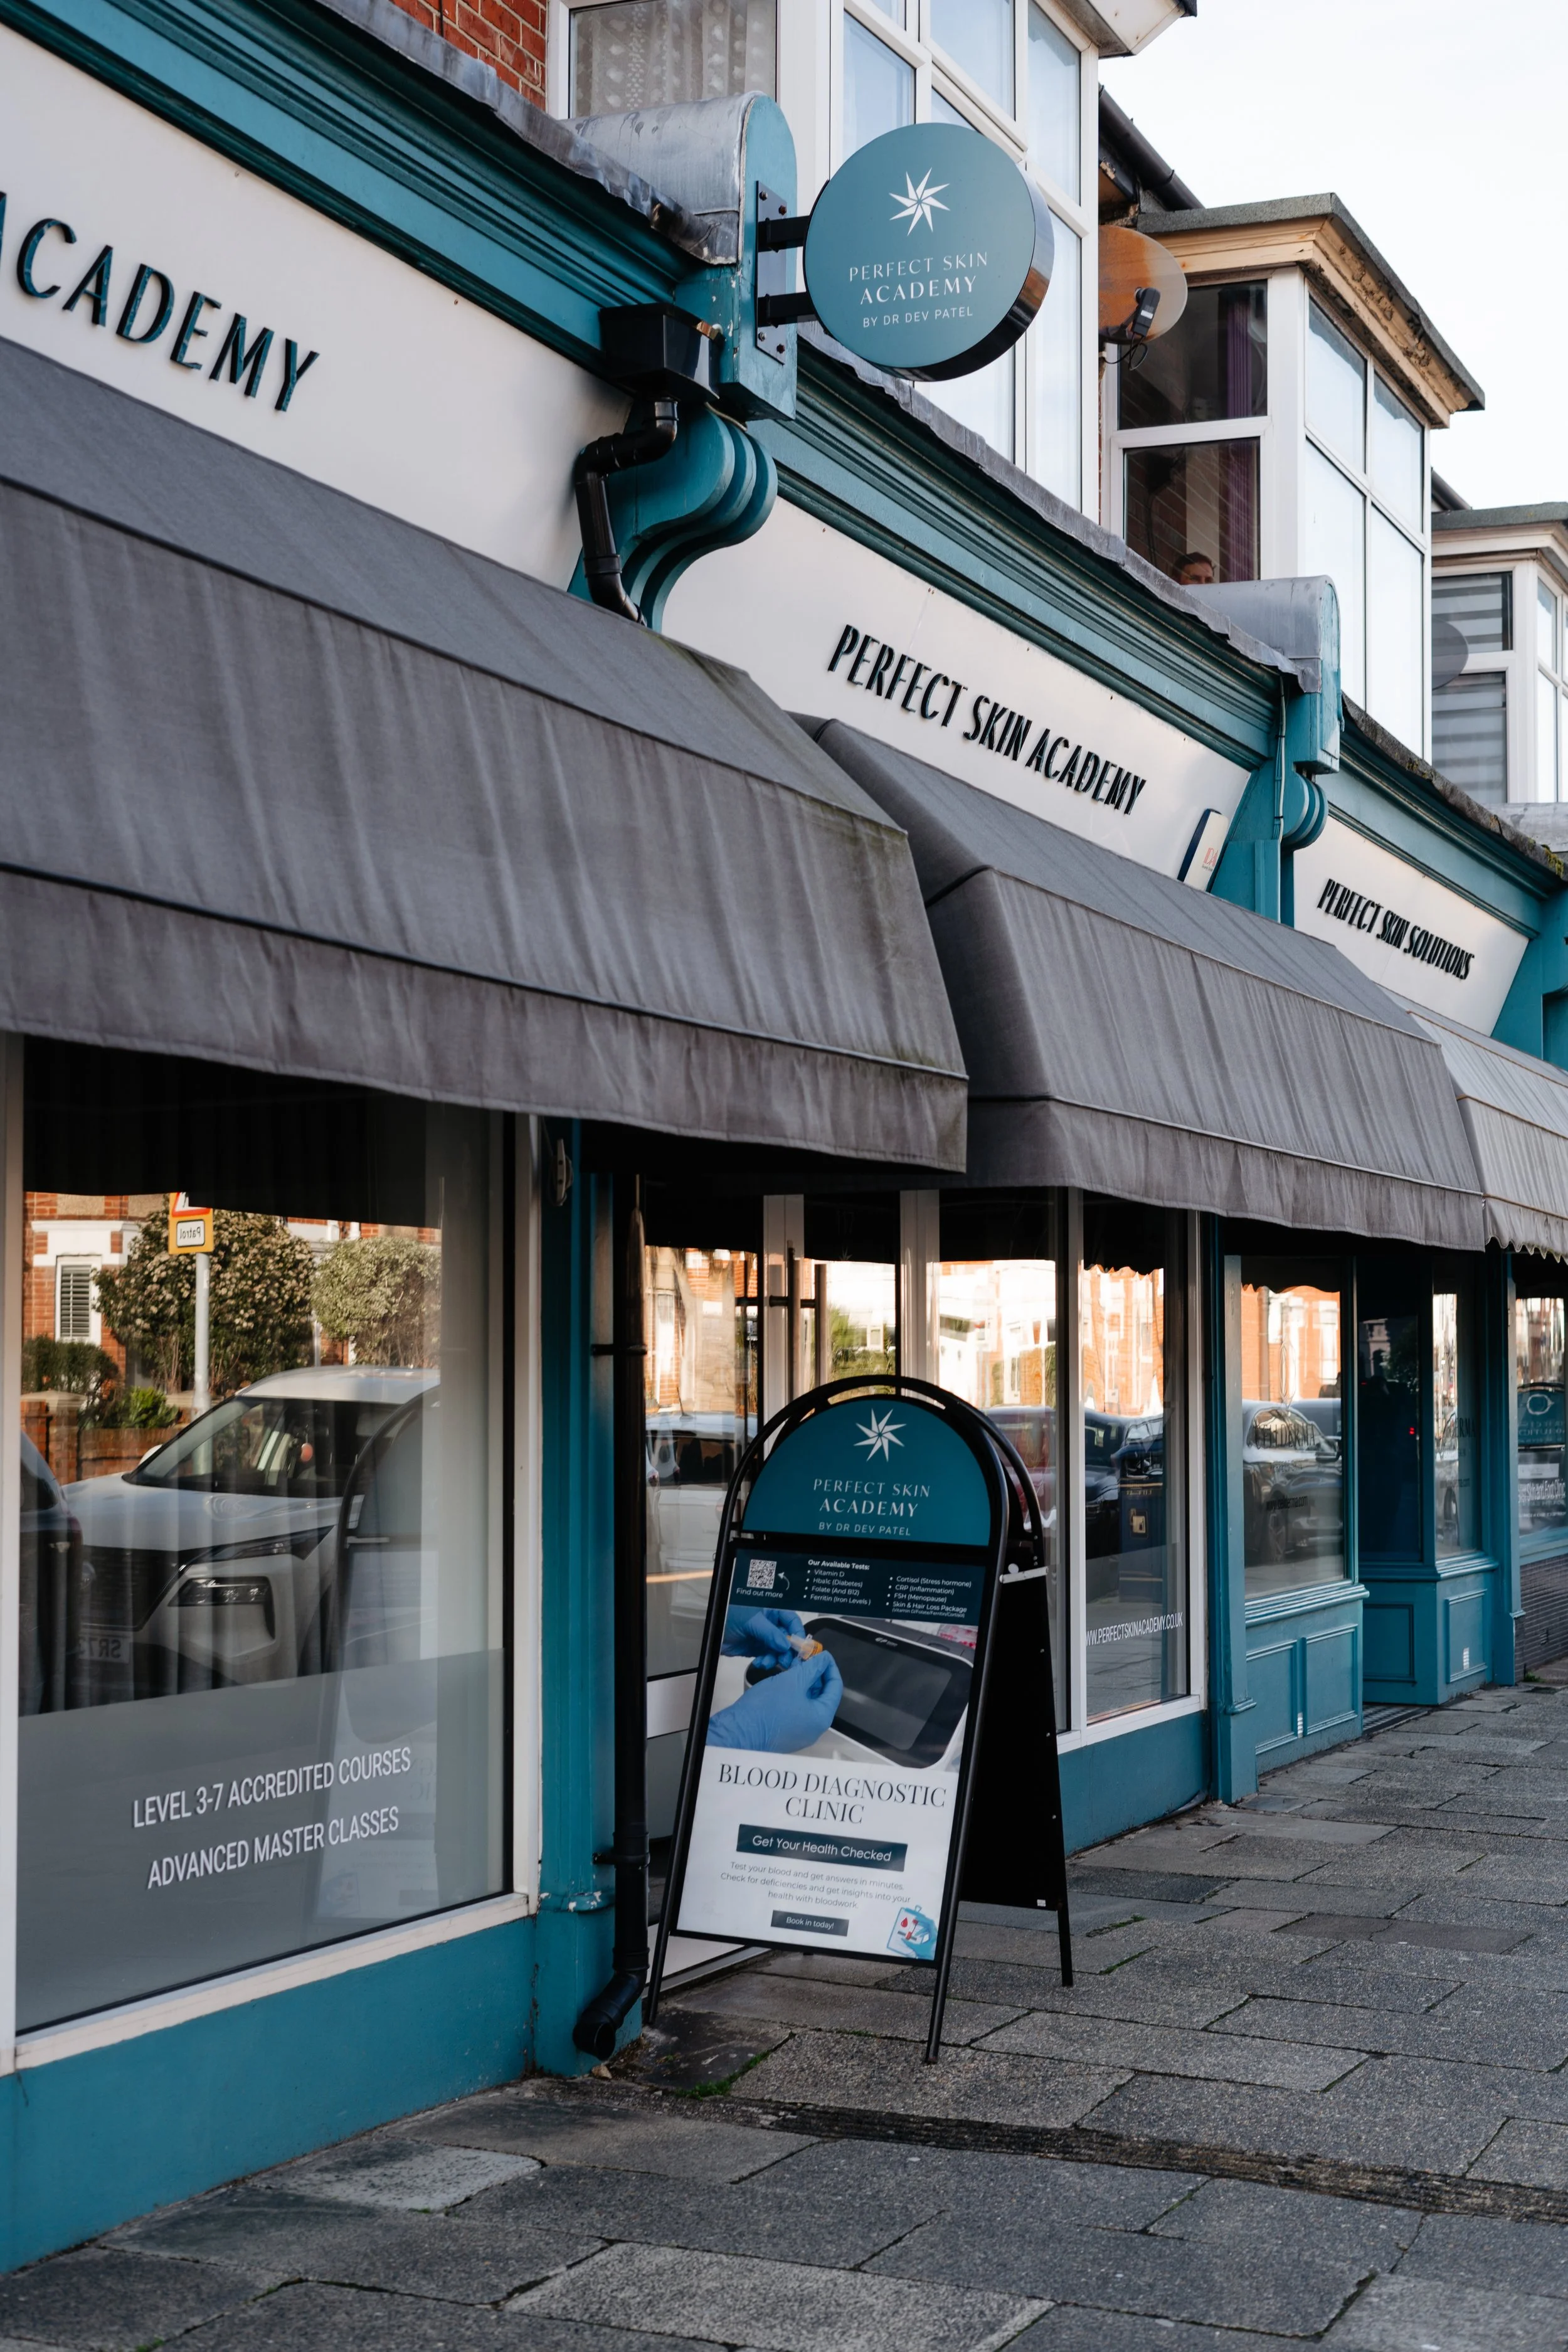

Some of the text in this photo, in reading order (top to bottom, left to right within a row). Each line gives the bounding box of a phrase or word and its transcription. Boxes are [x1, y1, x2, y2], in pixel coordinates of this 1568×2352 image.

[849, 252, 988, 282] PERFECT SKIN
[859, 275, 977, 305] ACADEMY
[0, 192, 320, 413] CADEMY
[863, 306, 973, 328] BY DR DEV PATEL
[828, 624, 1147, 815] PERFECT SKIN ACADEMY
[1316, 878, 1475, 980] PERFECT SKIN SOLUTIONS
[813, 1478, 931, 1498] PERFECT SKIN
[819, 1498, 918, 1518] ACADEMY
[818, 1522, 911, 1537] BY DR DEV PATEL
[821, 1560, 850, 1569] Available
[736, 1587, 751, 1596] Find
[832, 1579, 863, 1588] (Diabetes)
[896, 1576, 919, 1584] Cortisol
[941, 1579, 972, 1588] hormone)
[909, 1586, 954, 1596] (Inflammation)
[908, 1594, 947, 1604] (Menopause)
[941, 1605, 967, 1614] Package
[133, 1790, 191, 1828] LEVEL
[196, 1783, 224, 1814] 3-7
[228, 1761, 334, 1808] ACCREDITED
[339, 1747, 411, 1784] COURSES
[718, 1763, 946, 1808] BLOOD DIAGNOSTIC
[785, 1796, 865, 1825] CLINIC
[147, 1806, 400, 1889] ADVANCED MASTER CLASSES
[752, 1835, 892, 1862] Get Your Health Checked
[731, 1862, 904, 1890] Test your blood and get answers in minutes.
[721, 1872, 911, 1904] Check for deficiencies and get insights into your
[768, 1890, 859, 1909] health with bloodwork.
[786, 1916, 804, 1925] Book
[813, 1920, 834, 1931] today!
